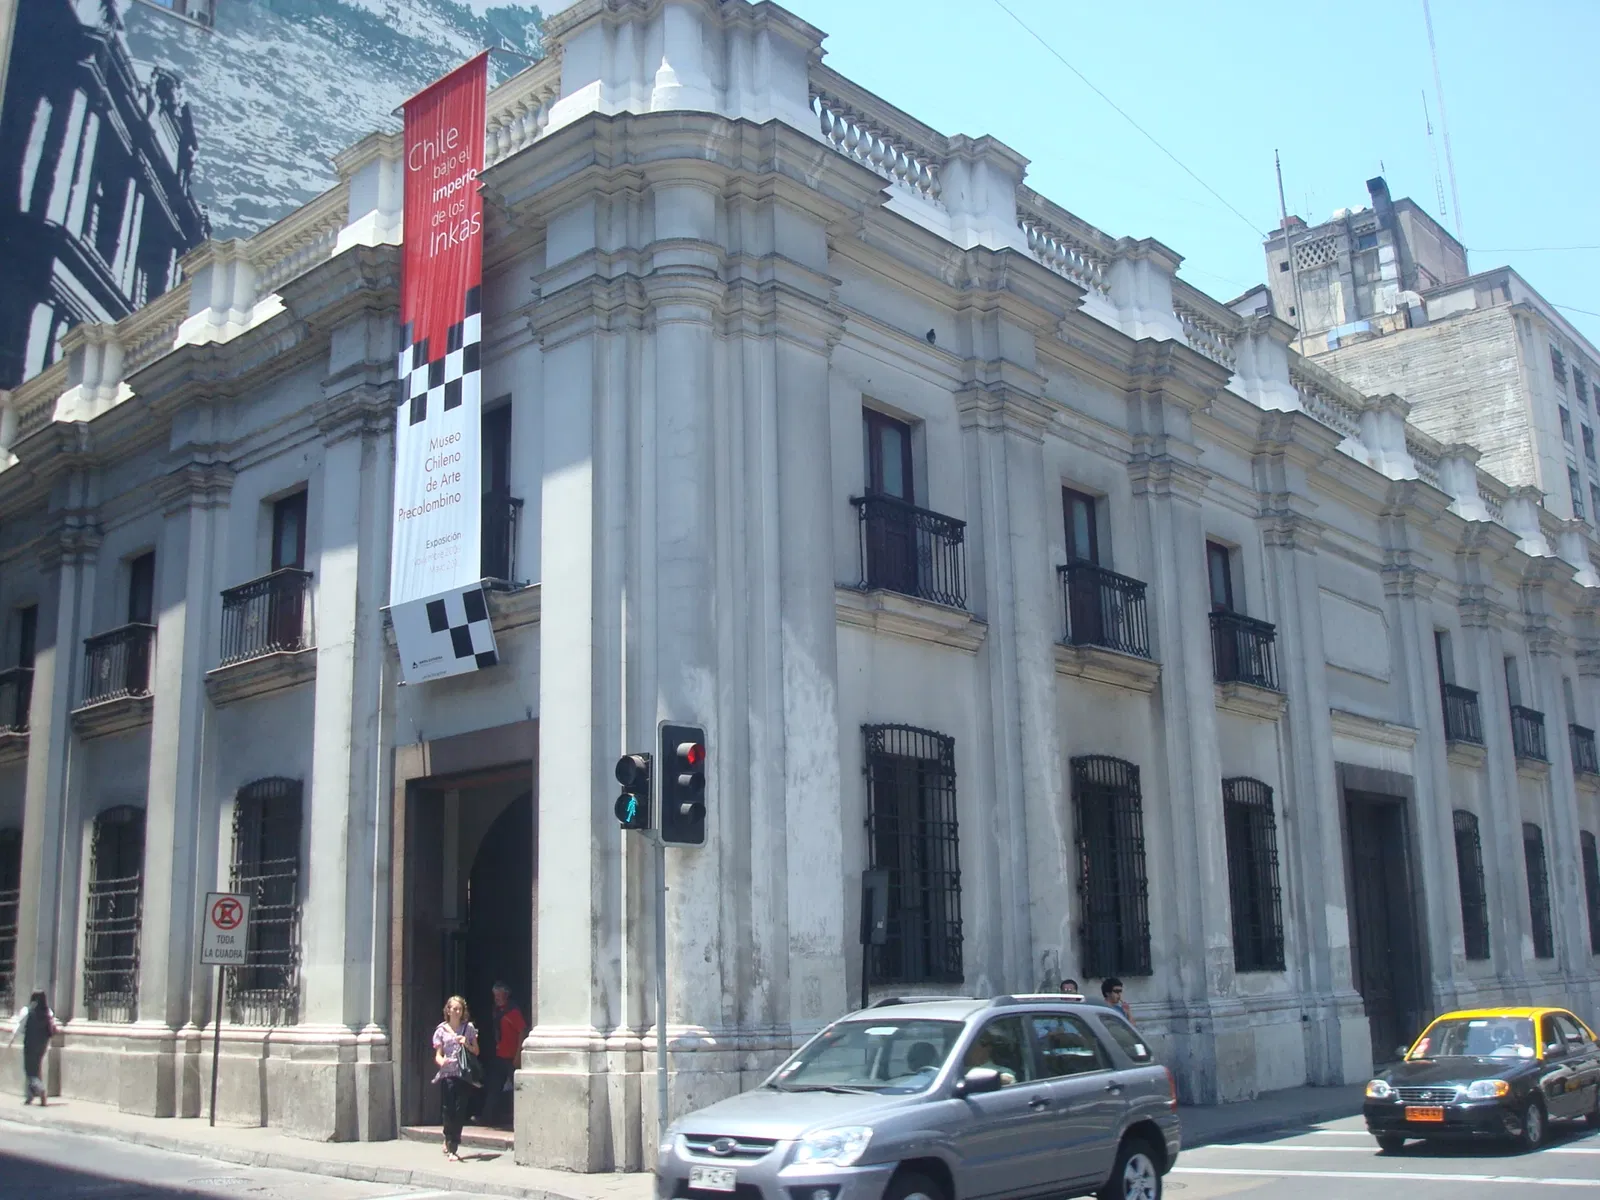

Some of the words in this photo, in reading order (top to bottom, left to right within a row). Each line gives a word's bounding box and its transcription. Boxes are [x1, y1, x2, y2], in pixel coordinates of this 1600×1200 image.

[408, 127, 459, 172] Chile
[433, 156, 457, 179] bajo
[458, 145, 471, 163] el
[432, 167, 477, 203] imperio
[431, 210, 447, 227] de
[448, 199, 465, 219] los
[429, 212, 481, 258] Inkas
[429, 432, 461, 452] Museo
[424, 452, 461, 472] Chileno
[426, 476, 438, 492] de
[440, 472, 461, 487] Arte
[398, 492, 461, 522] Precolombino
[425, 532, 462, 549] Exposición
[216, 934, 235, 944] TODA
[204, 948, 213, 957] LA
[215, 948, 243, 959] CUADRA
